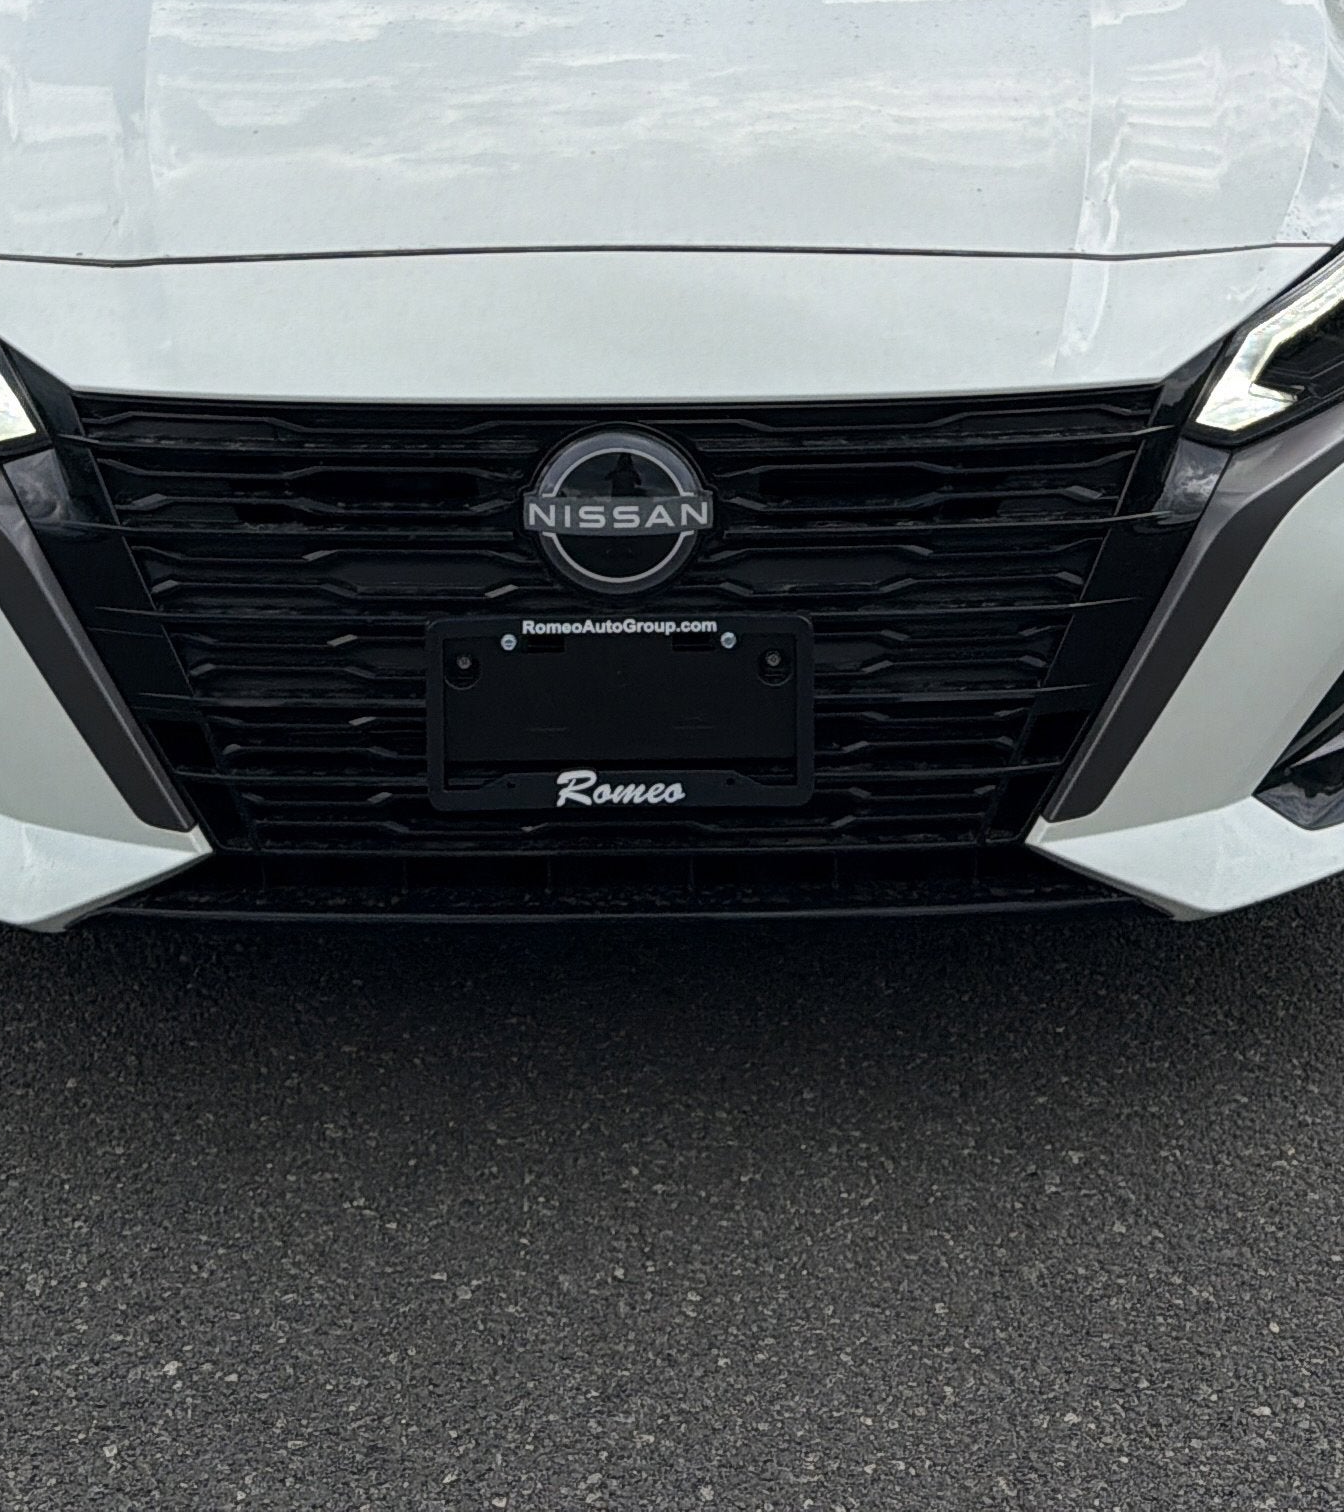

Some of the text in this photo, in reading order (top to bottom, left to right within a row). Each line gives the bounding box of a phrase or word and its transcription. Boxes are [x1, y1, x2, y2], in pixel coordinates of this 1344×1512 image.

[528, 501, 708, 529] NISSAN
[522, 619, 718, 636] RomeoAutoGroup.com
[556, 769, 686, 807] Romeo
